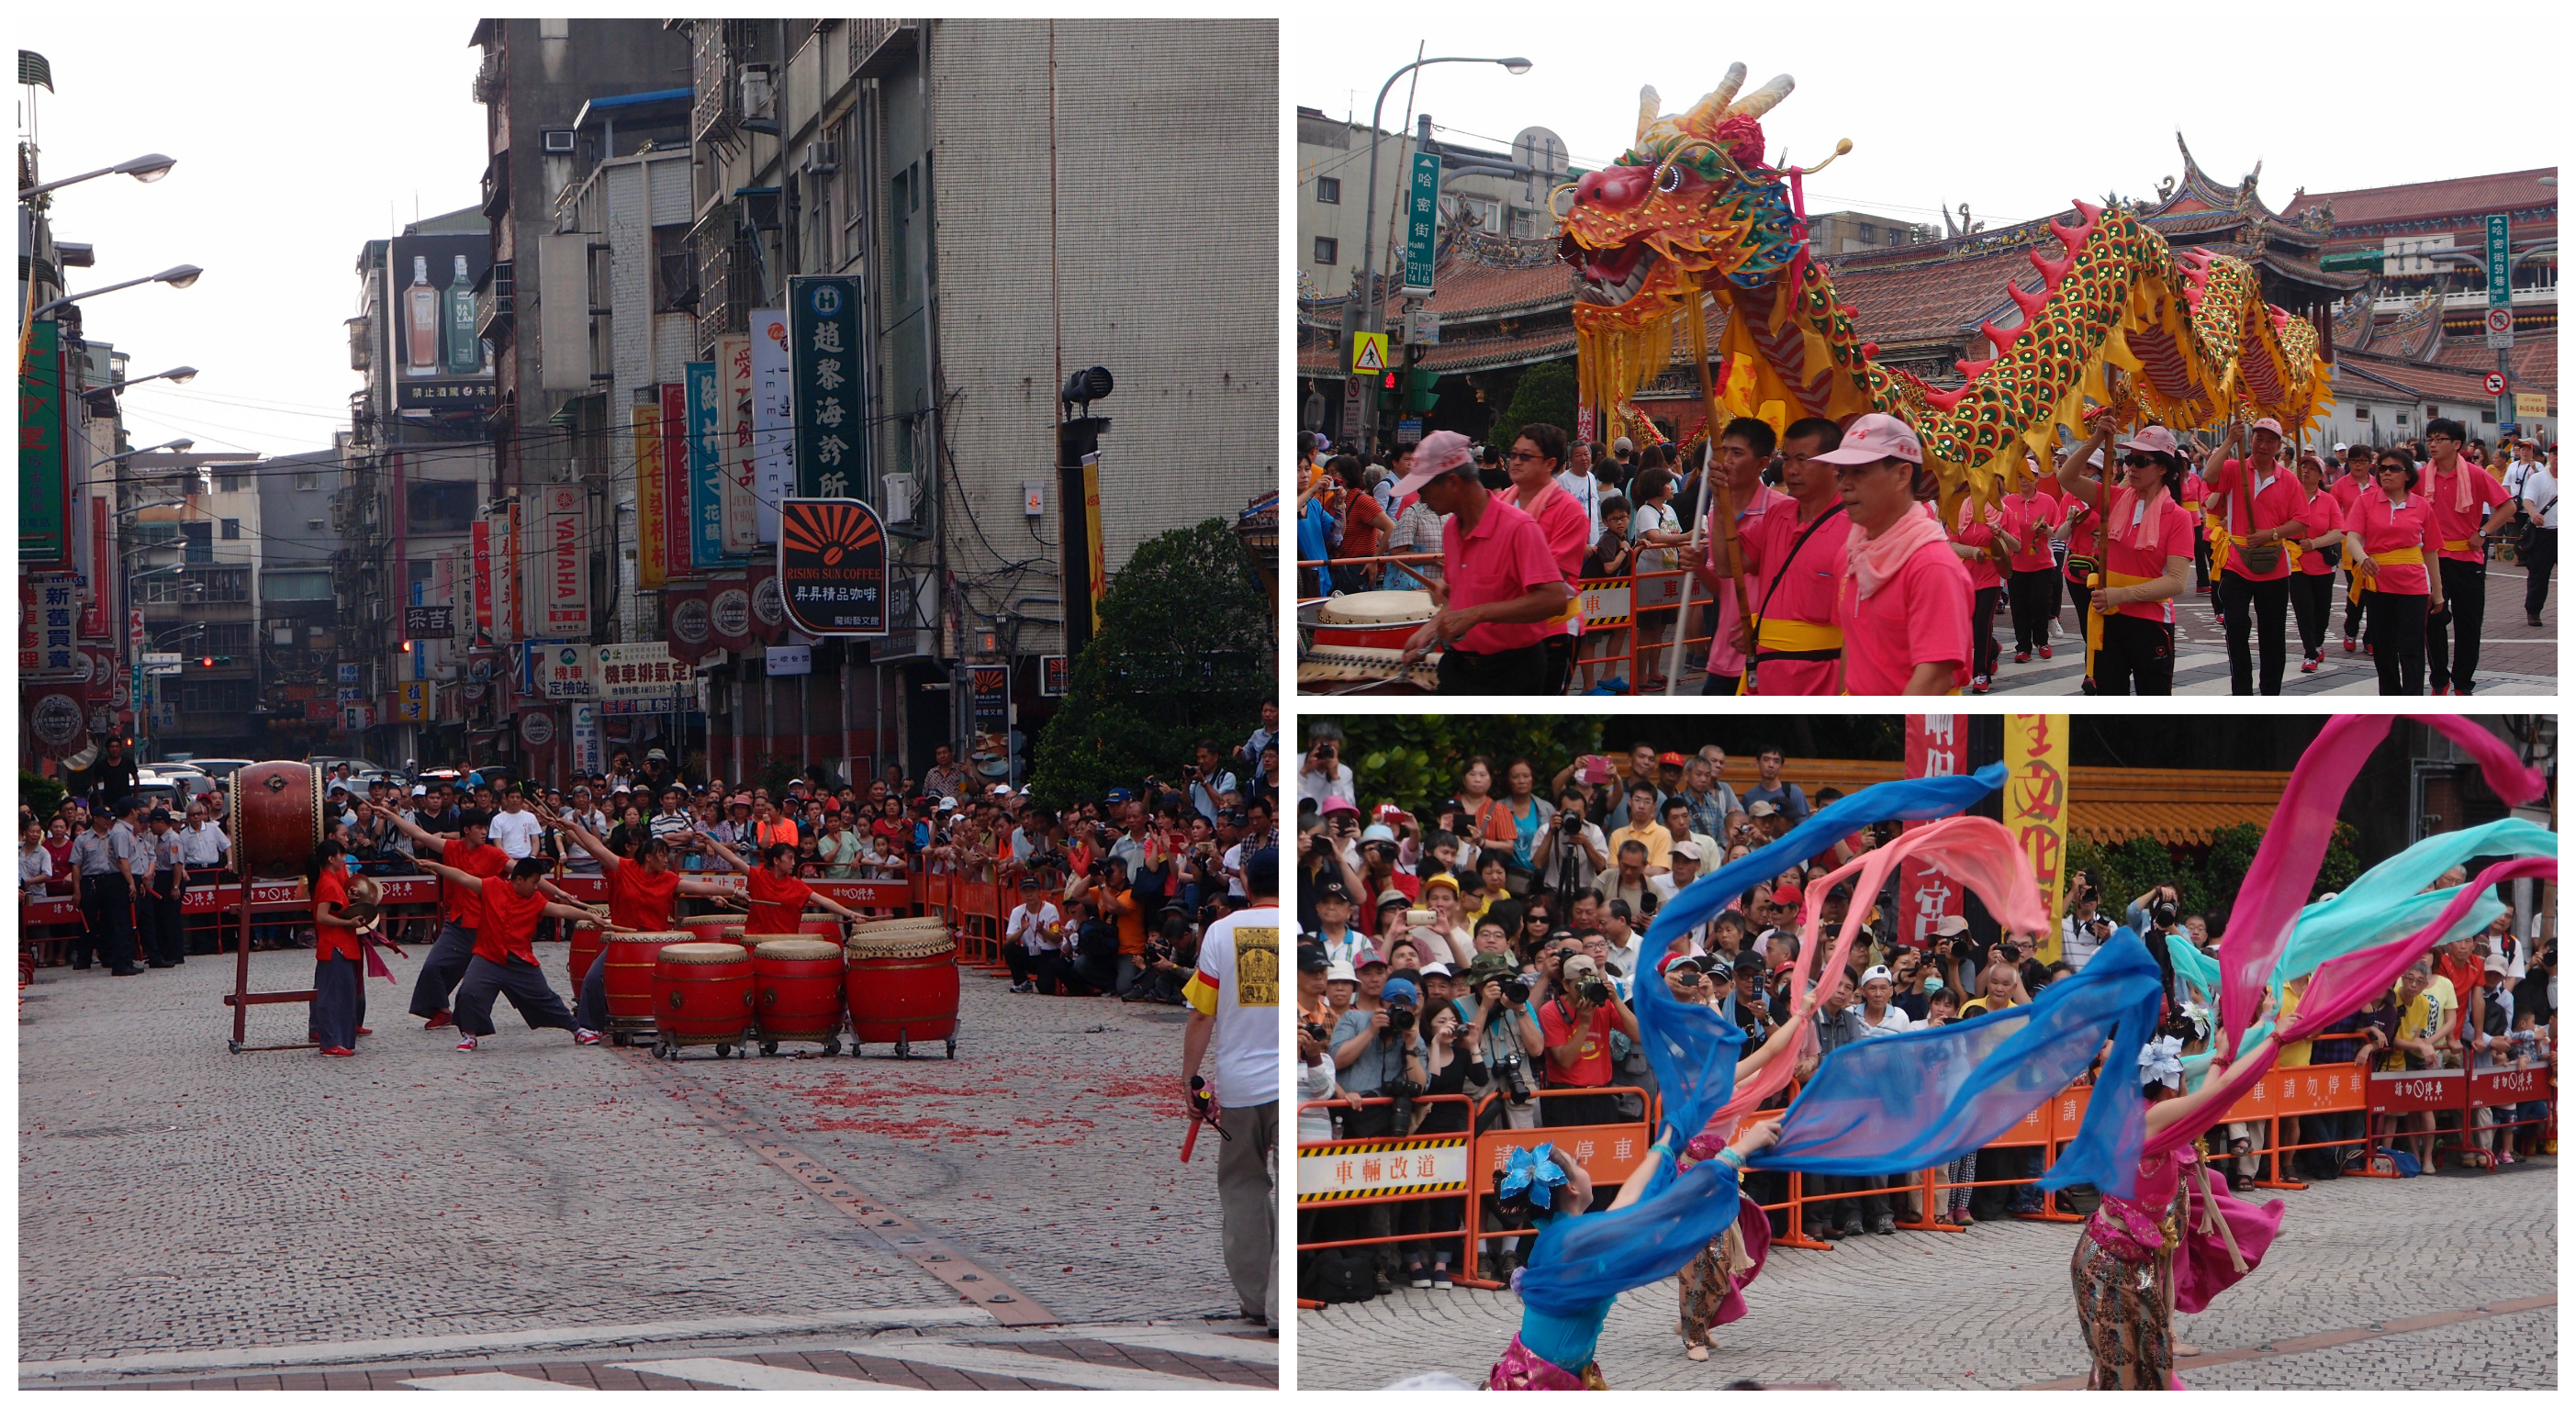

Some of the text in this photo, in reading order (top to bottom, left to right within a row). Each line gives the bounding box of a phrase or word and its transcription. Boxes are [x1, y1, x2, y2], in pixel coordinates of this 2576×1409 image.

[1414, 173, 1433, 239] 哈密街
[1408, 240, 1425, 250] HaMi
[1408, 250, 1417, 259] St.
[2492, 225, 2505, 286] 哈密街59巷
[1407, 262, 1432, 272] 122 113
[1408, 274, 1429, 284] 74 65
[412, 386, 460, 397] 禁止酒駕
[812, 321, 850, 498] 趙黎海診所
[733, 496, 755, 507] JEWE
[556, 517, 577, 599] YAMAHA
[787, 568, 881, 580] RISING SUN COFFEE
[795, 586, 878, 602] 昇昇精品咖啡
[1585, 594, 1601, 614] 車
[46, 587, 71, 669] 新舊買賣
[554, 665, 583, 680] 機車
[548, 681, 589, 696] 定檢站
[407, 684, 423, 720] 植牙
[2284, 1073, 2361, 1099] 請勿停車
[2394, 1079, 2443, 1097] 請勿停車
[2492, 1072, 2533, 1090] 請勿停車
[2063, 1100, 2077, 1122] 請
[1494, 1136, 1633, 1172] 請停車
[1334, 1154, 1435, 1185] 車輛改道
